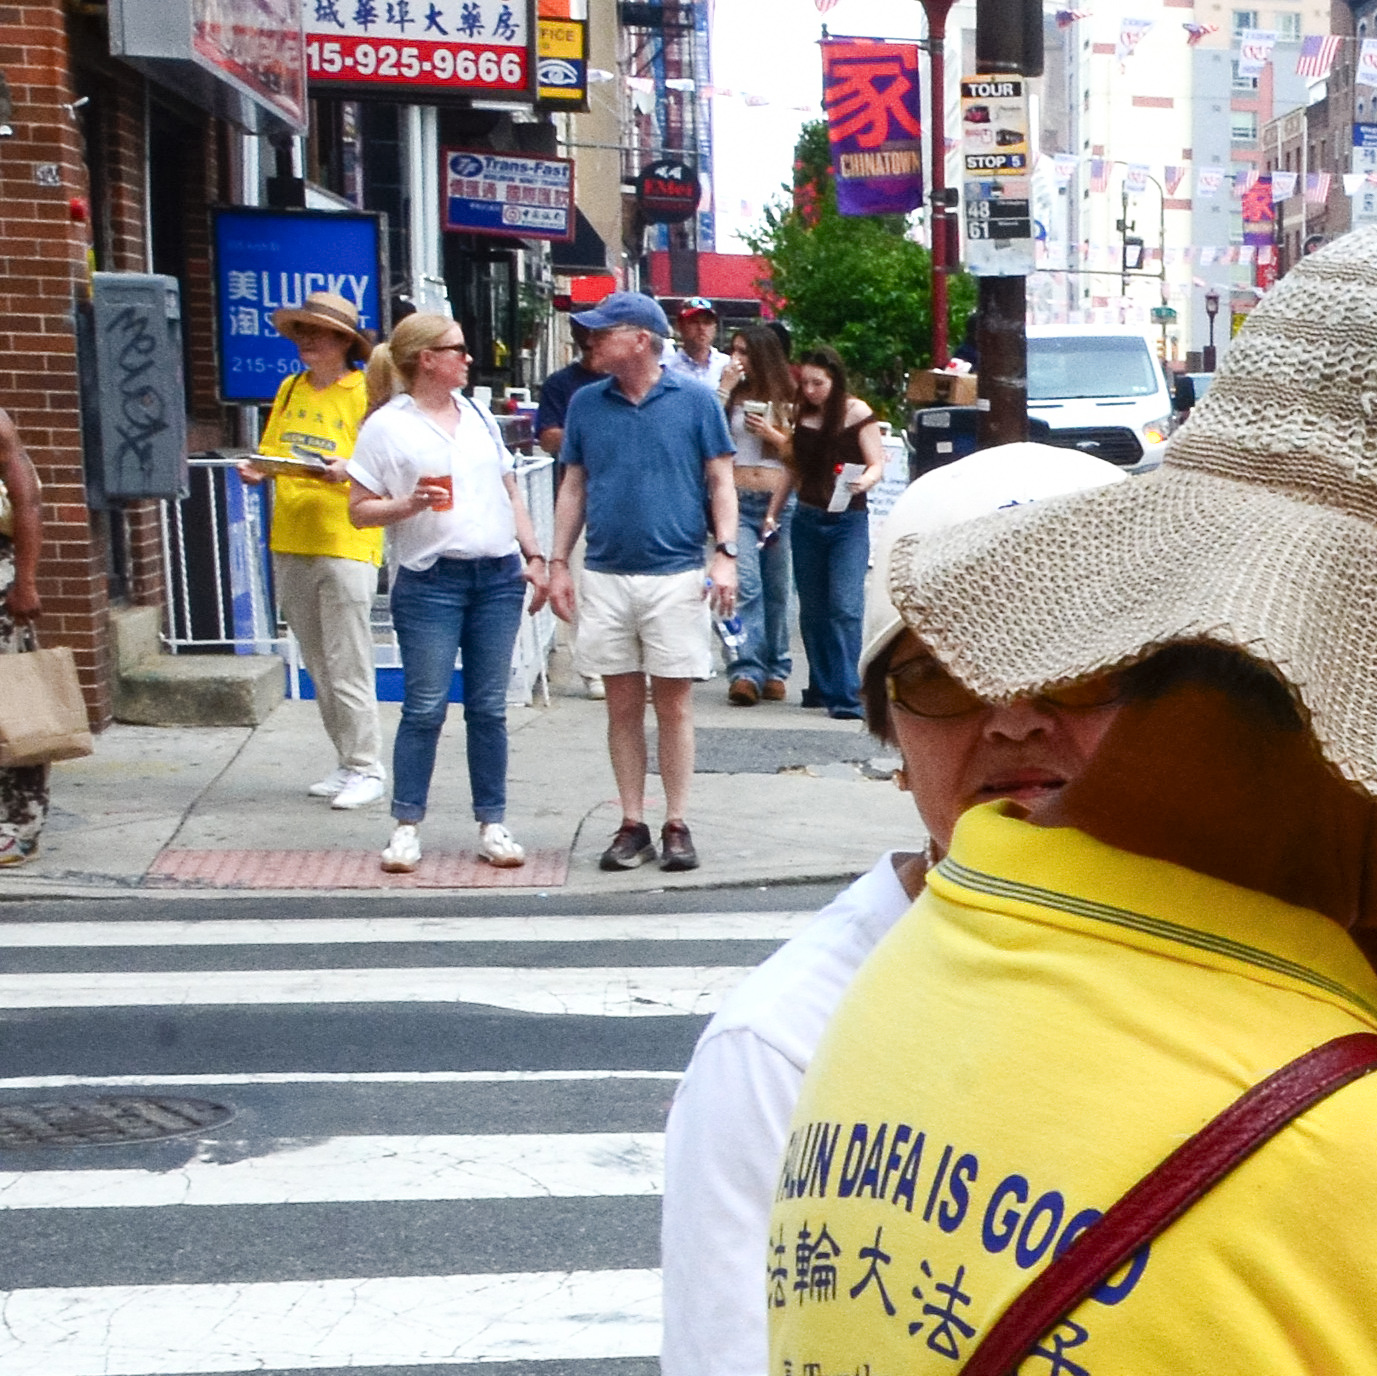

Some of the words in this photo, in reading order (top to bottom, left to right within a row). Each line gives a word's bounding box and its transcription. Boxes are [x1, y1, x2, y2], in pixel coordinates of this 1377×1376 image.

[820, 44, 921, 148] 家
[969, 83, 1014, 97] TOUR
[484, 156, 569, 178] Trans-Fast
[840, 151, 921, 178] CHINATOWN
[967, 156, 1007, 168] STOP
[1011, 154, 1021, 167] 5
[967, 200, 990, 218] 48
[968, 221, 990, 238] 61
[262, 271, 369, 311] LUCKY
[232, 357, 301, 374] 215-50
[838, 1123, 926, 1212] DAFA
[923, 1145, 978, 1233] IS
